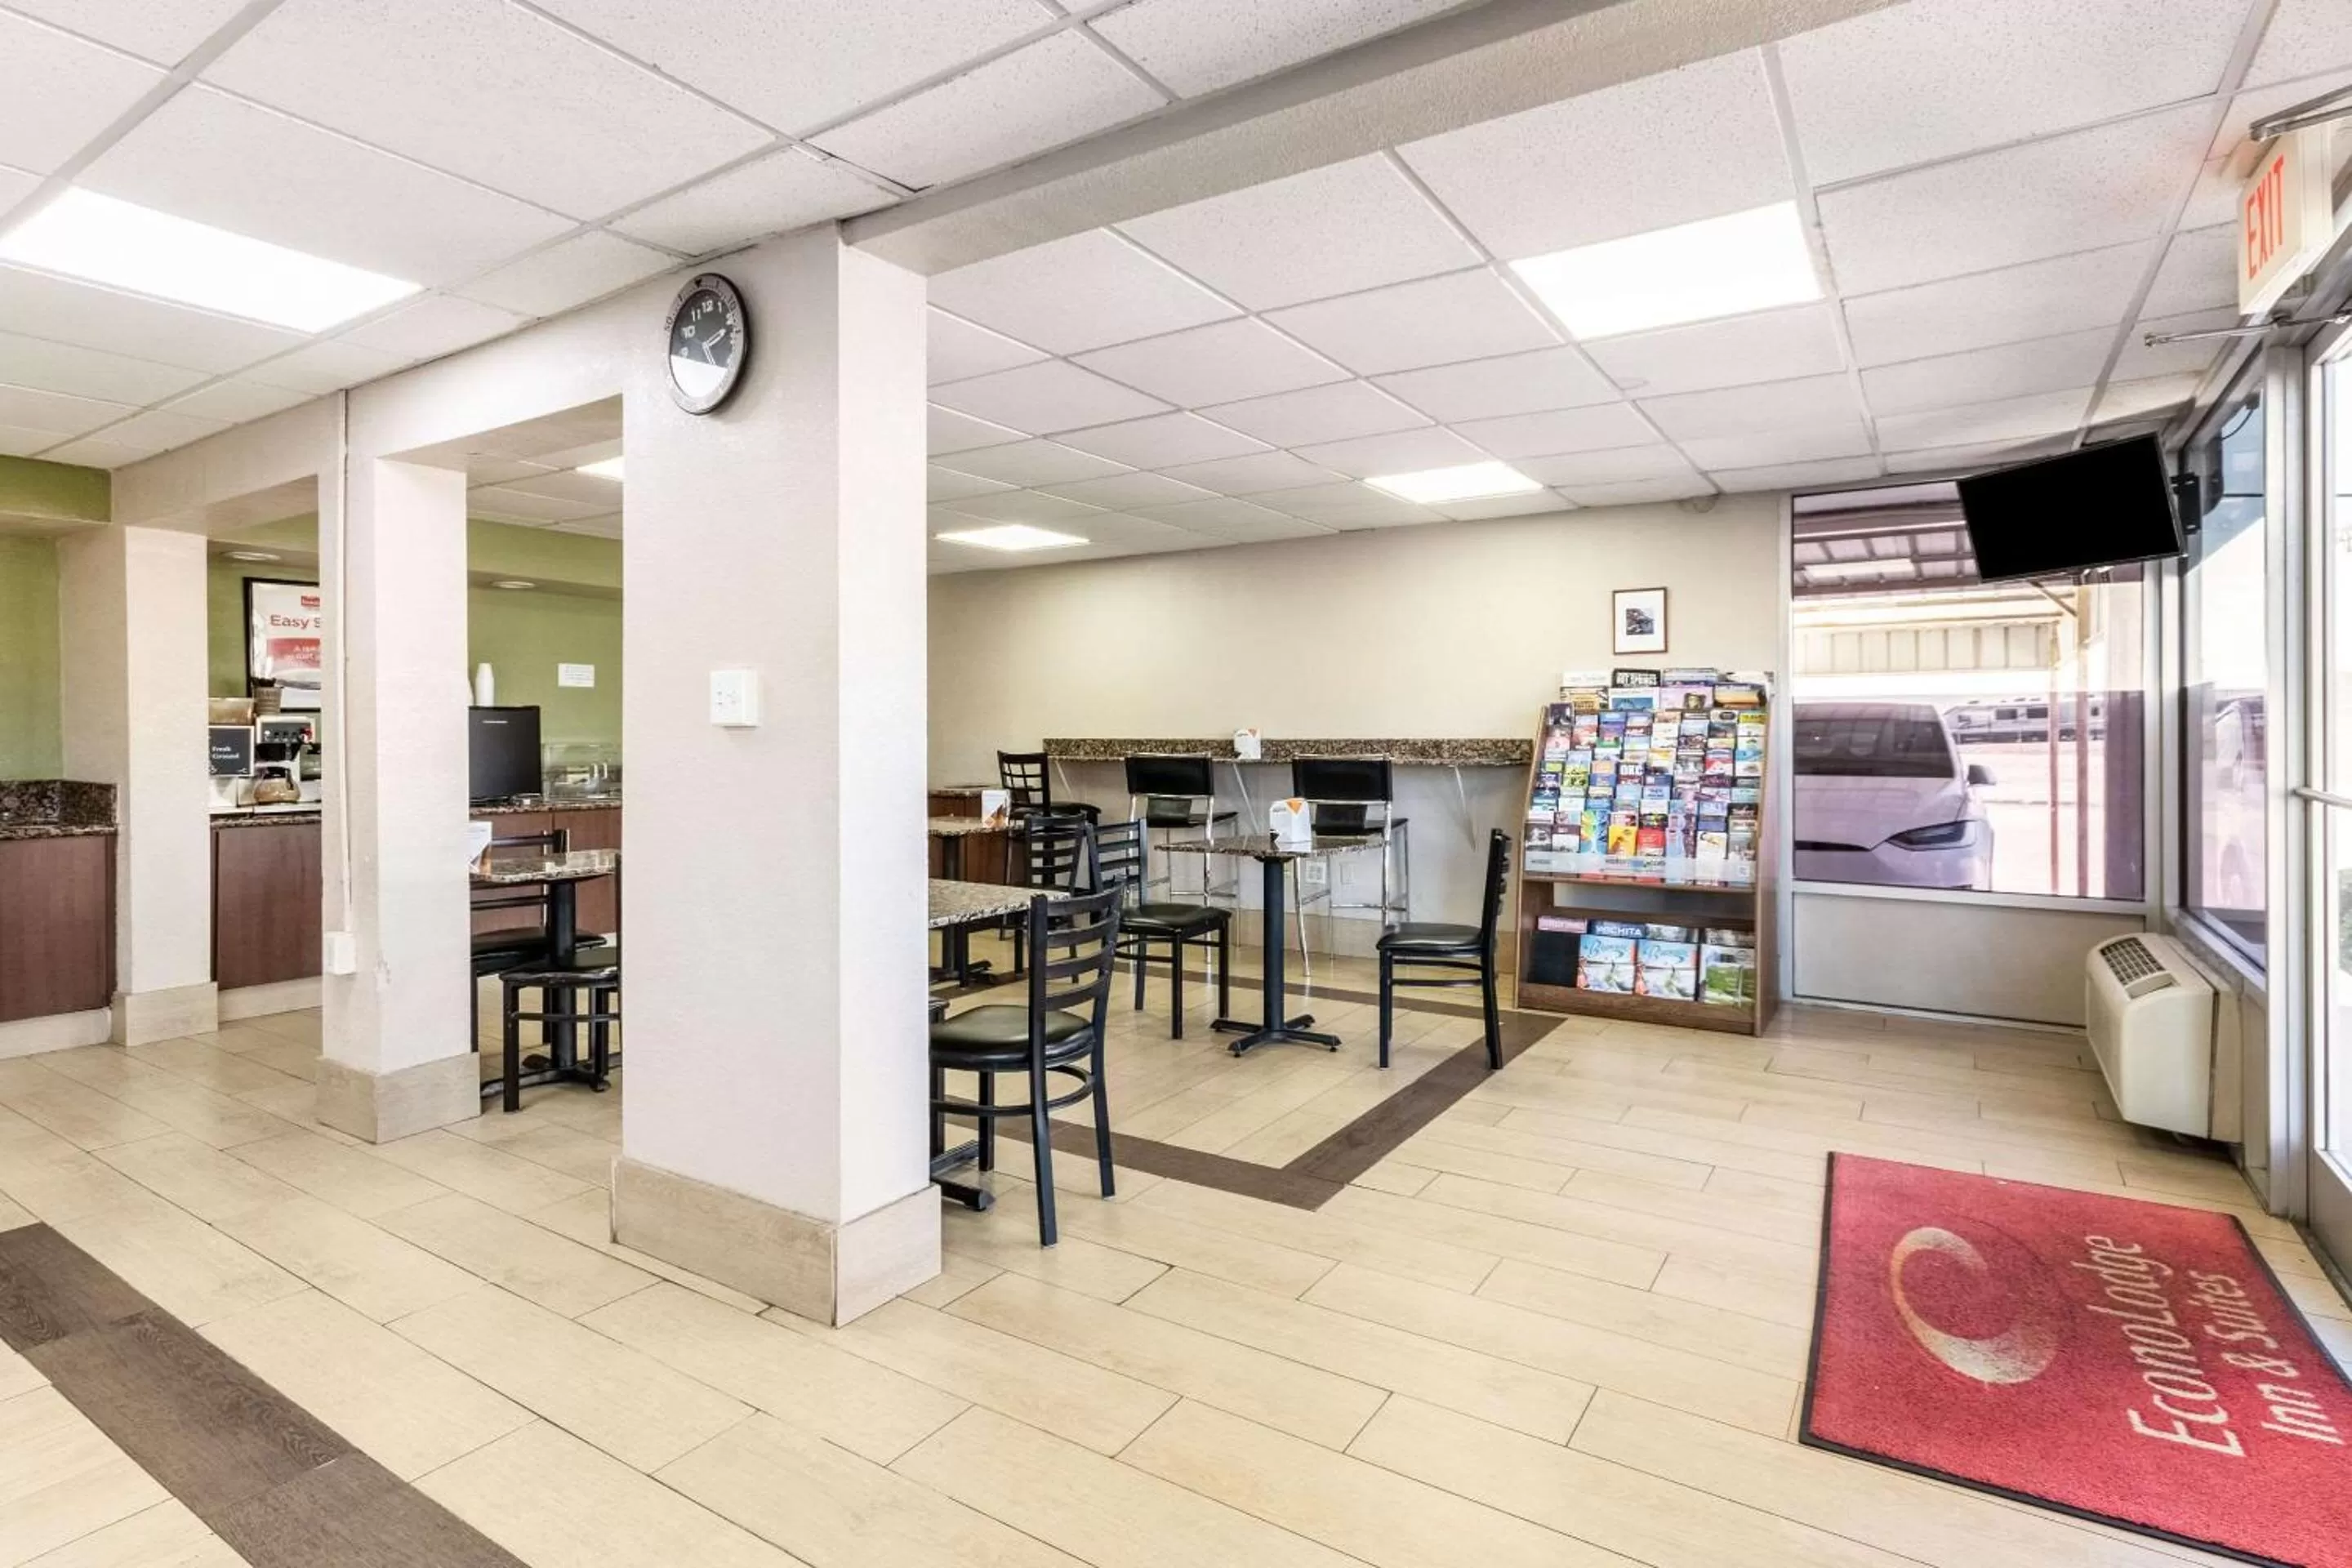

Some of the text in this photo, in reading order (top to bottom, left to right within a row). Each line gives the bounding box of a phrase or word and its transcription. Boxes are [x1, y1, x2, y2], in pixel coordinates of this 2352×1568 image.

[2245, 154, 2284, 279] EXIT
[702, 300, 713, 313] 12
[692, 309, 702, 322] 11
[682, 325, 696, 340] 10
[270, 614, 310, 630] Easy
[1595, 923, 1643, 937] WICHITA
[2221, 1352, 2301, 1378] &
[2256, 1383, 2345, 1446] Inn
